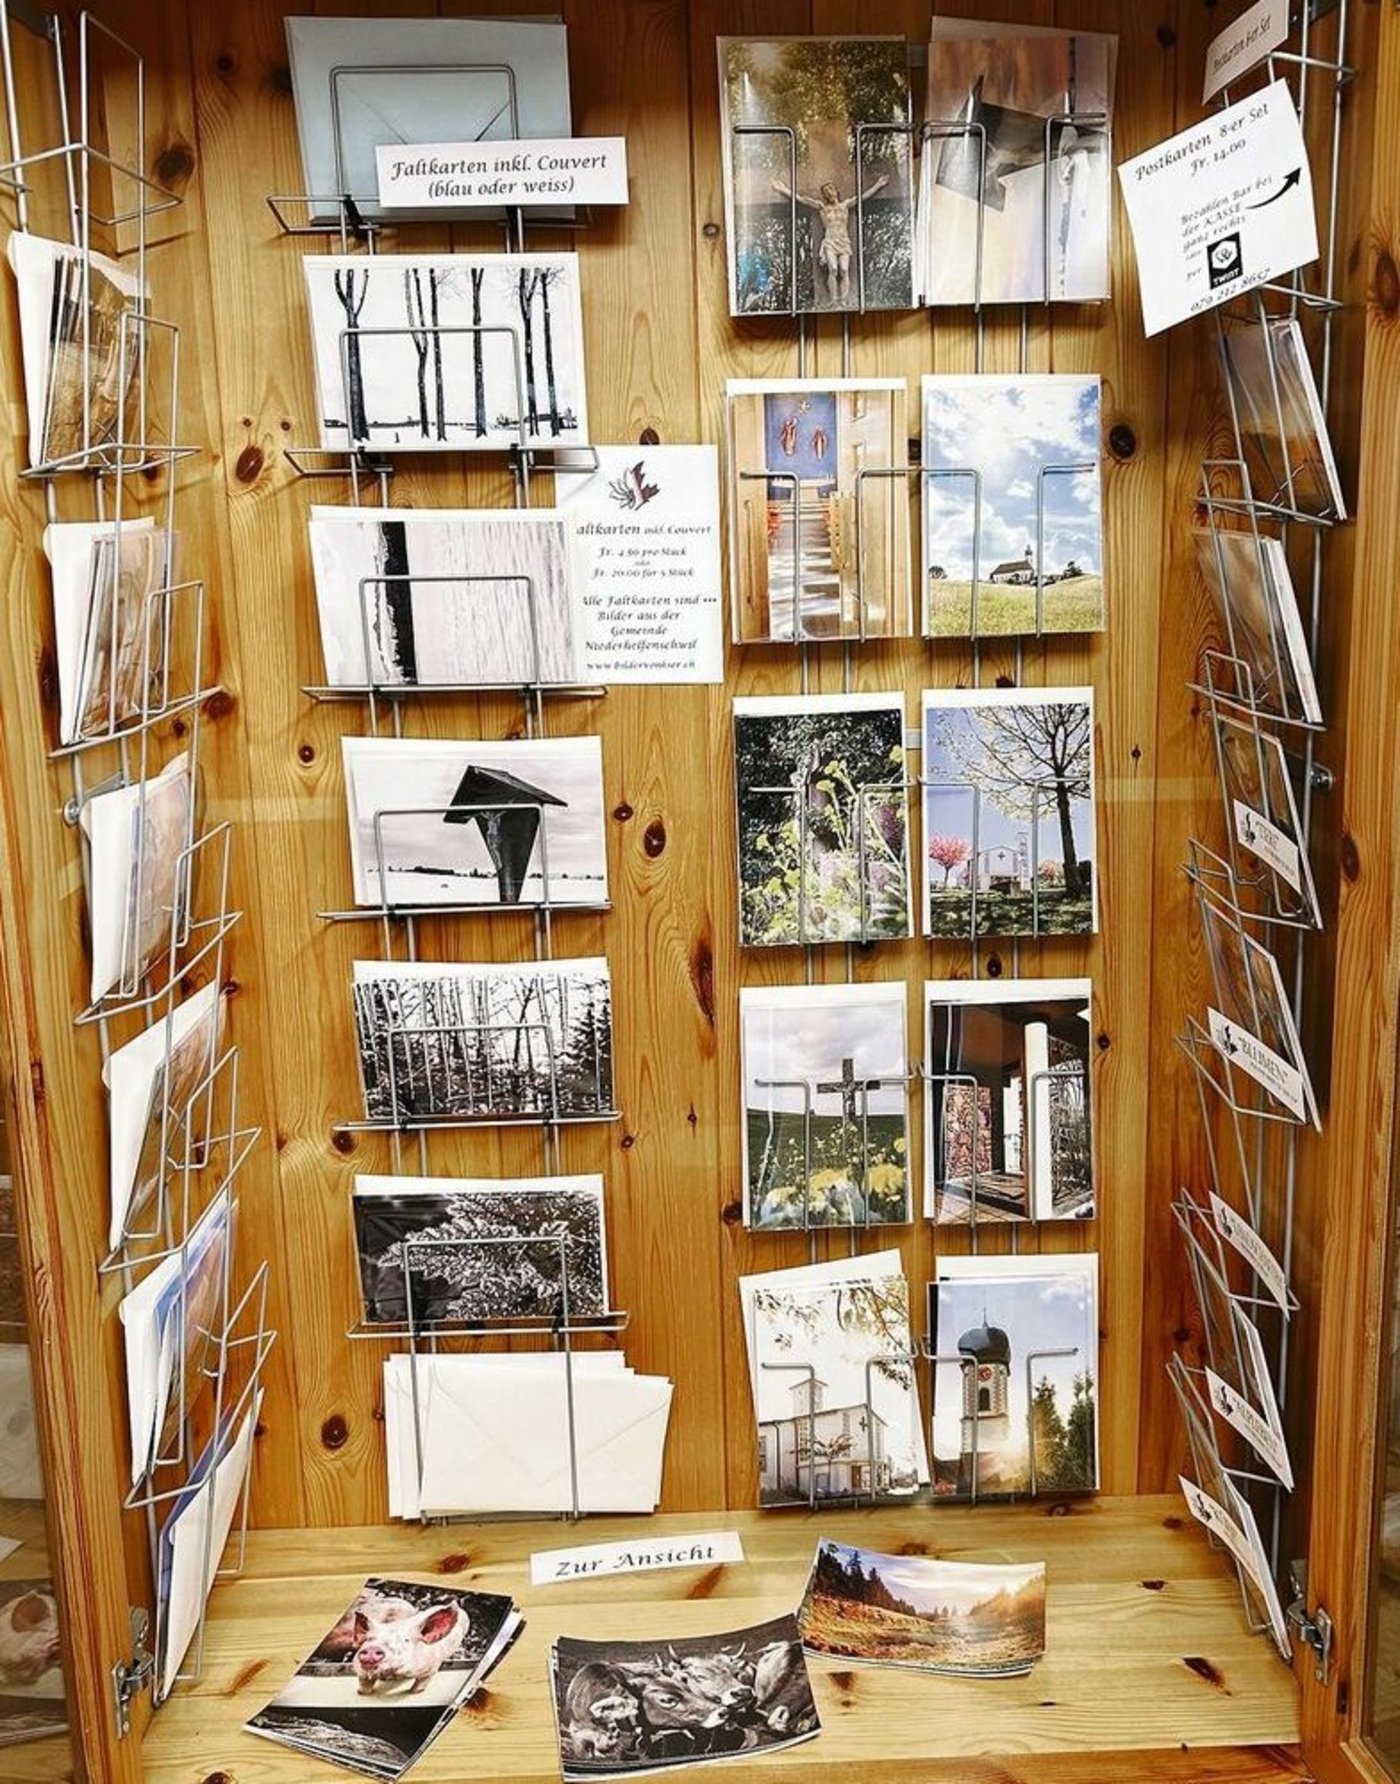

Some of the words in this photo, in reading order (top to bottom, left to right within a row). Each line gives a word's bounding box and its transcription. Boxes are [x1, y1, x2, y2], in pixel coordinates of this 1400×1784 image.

[1135, 134, 1212, 181] Postkarten
[1219, 115, 1245, 138] 8-er
[1250, 102, 1269, 124] Set
[391, 157, 487, 180] Faltkarten
[494, 155, 531, 172] inkl.
[537, 154, 607, 171] Couvert
[1191, 156, 1210, 176] Fr.
[1214, 139, 1247, 162] 14.00
[428, 181, 472, 198] (blau
[478, 179, 517, 195] oder
[523, 176, 575, 193] weiss)
[1182, 223, 1200, 237] der
[1204, 202, 1240, 228] KASSE
[1213, 267, 1240, 286] TWINT
[576, 522, 640, 535] altkarten
[607, 594, 670, 607] Faltkarten
[597, 610, 633, 621] Bilder
[637, 611, 657, 621] aus
[660, 609, 681, 620] der
[610, 625, 667, 636] Gemeinde
[555, 1560, 603, 1576] Zur
[613, 1544, 715, 1569] Ansicht
